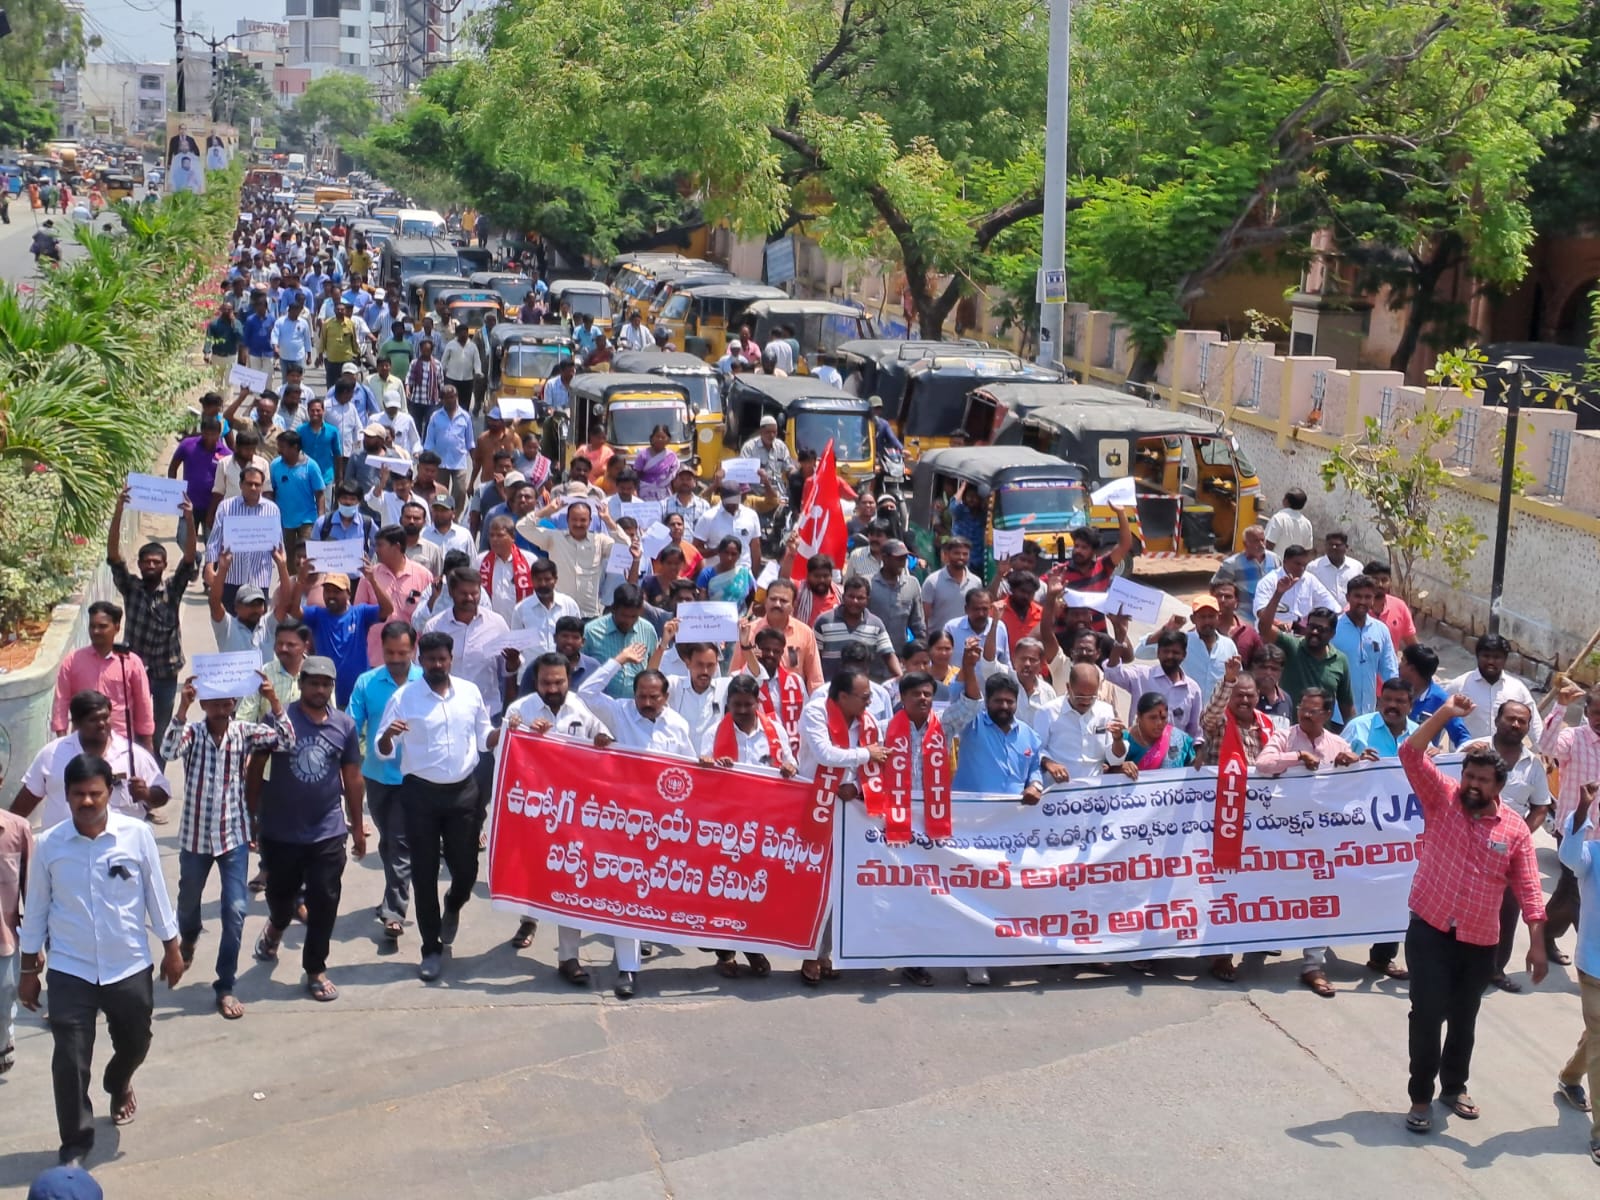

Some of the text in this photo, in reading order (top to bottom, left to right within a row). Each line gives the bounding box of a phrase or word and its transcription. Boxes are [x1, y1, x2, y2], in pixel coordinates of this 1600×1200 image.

[813, 767, 837, 823] TUC
[892, 756, 906, 823] CITU
[930, 751, 945, 819] CITU
[1042, 786, 1273, 817] అనంతపురము నగరపాల ంస్థ
[1221, 759, 1241, 839] AITUC
[507, 780, 577, 834] ఉద్యోగ
[581, 794, 692, 851] ఉపాధ్యాయ
[697, 821, 758, 863] కార్మిక
[973, 829, 1040, 854] మున్సిపల్
[1046, 824, 1097, 851] ఉద్యోగ
[1101, 825, 1116, 842] &
[1120, 820, 1178, 846] కార్మికుల
[1256, 810, 1314, 836] యాక్షన్
[1371, 793, 1424, 831] (JA
[546, 840, 589, 889] ఐక్య
[593, 850, 704, 899] కార్యాచరణ
[857, 859, 1012, 896] మున్సిపల్
[550, 889, 748, 932] అనంతపురము జిల్లా శాఖ
[994, 893, 1340, 945] వారిపై అరెస్ట్ చేయాలి
